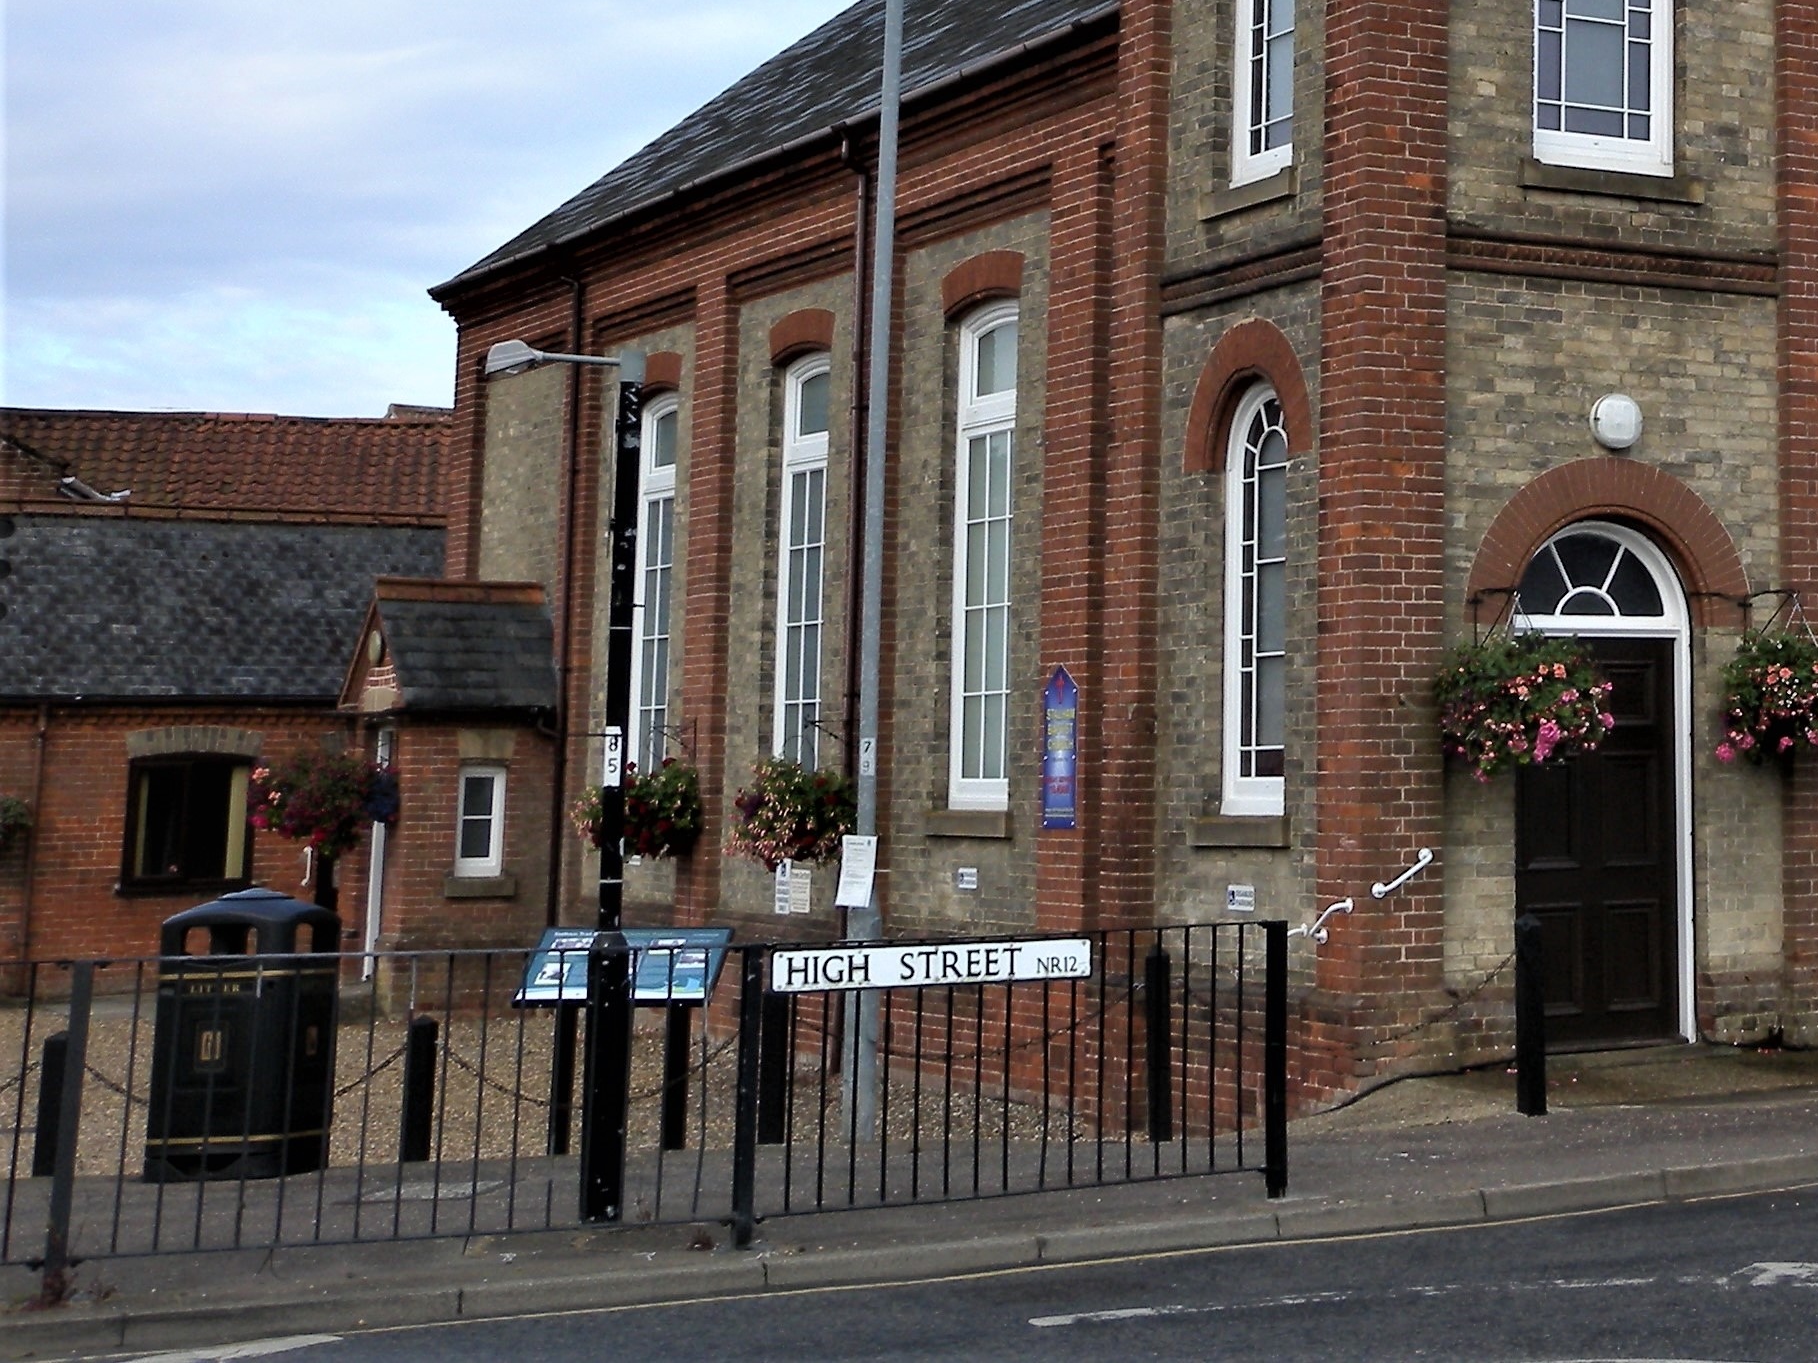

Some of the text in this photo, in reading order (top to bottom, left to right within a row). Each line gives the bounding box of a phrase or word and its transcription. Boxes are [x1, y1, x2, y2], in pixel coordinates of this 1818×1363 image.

[785, 946, 1079, 986] HIGH STREET NR12
